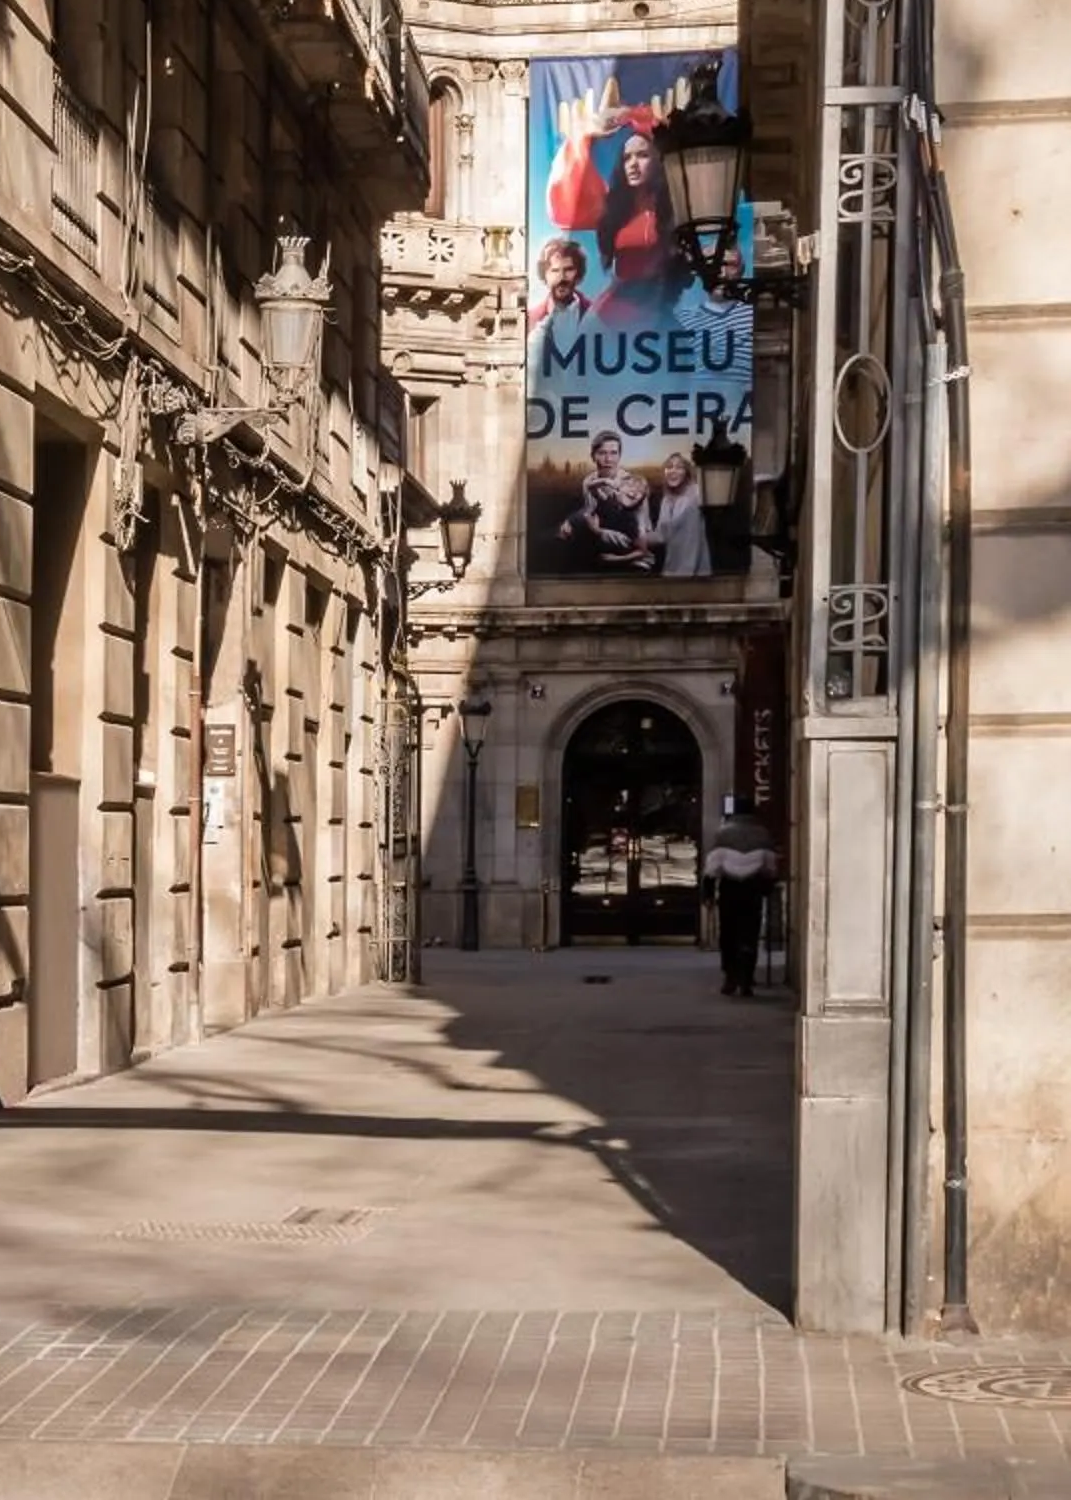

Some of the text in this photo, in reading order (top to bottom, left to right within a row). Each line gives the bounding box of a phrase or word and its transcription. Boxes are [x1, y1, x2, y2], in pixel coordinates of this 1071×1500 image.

[542, 329, 735, 377] MUSEU
[527, 395, 590, 440] DE
[754, 708, 772, 806] TICKETS
